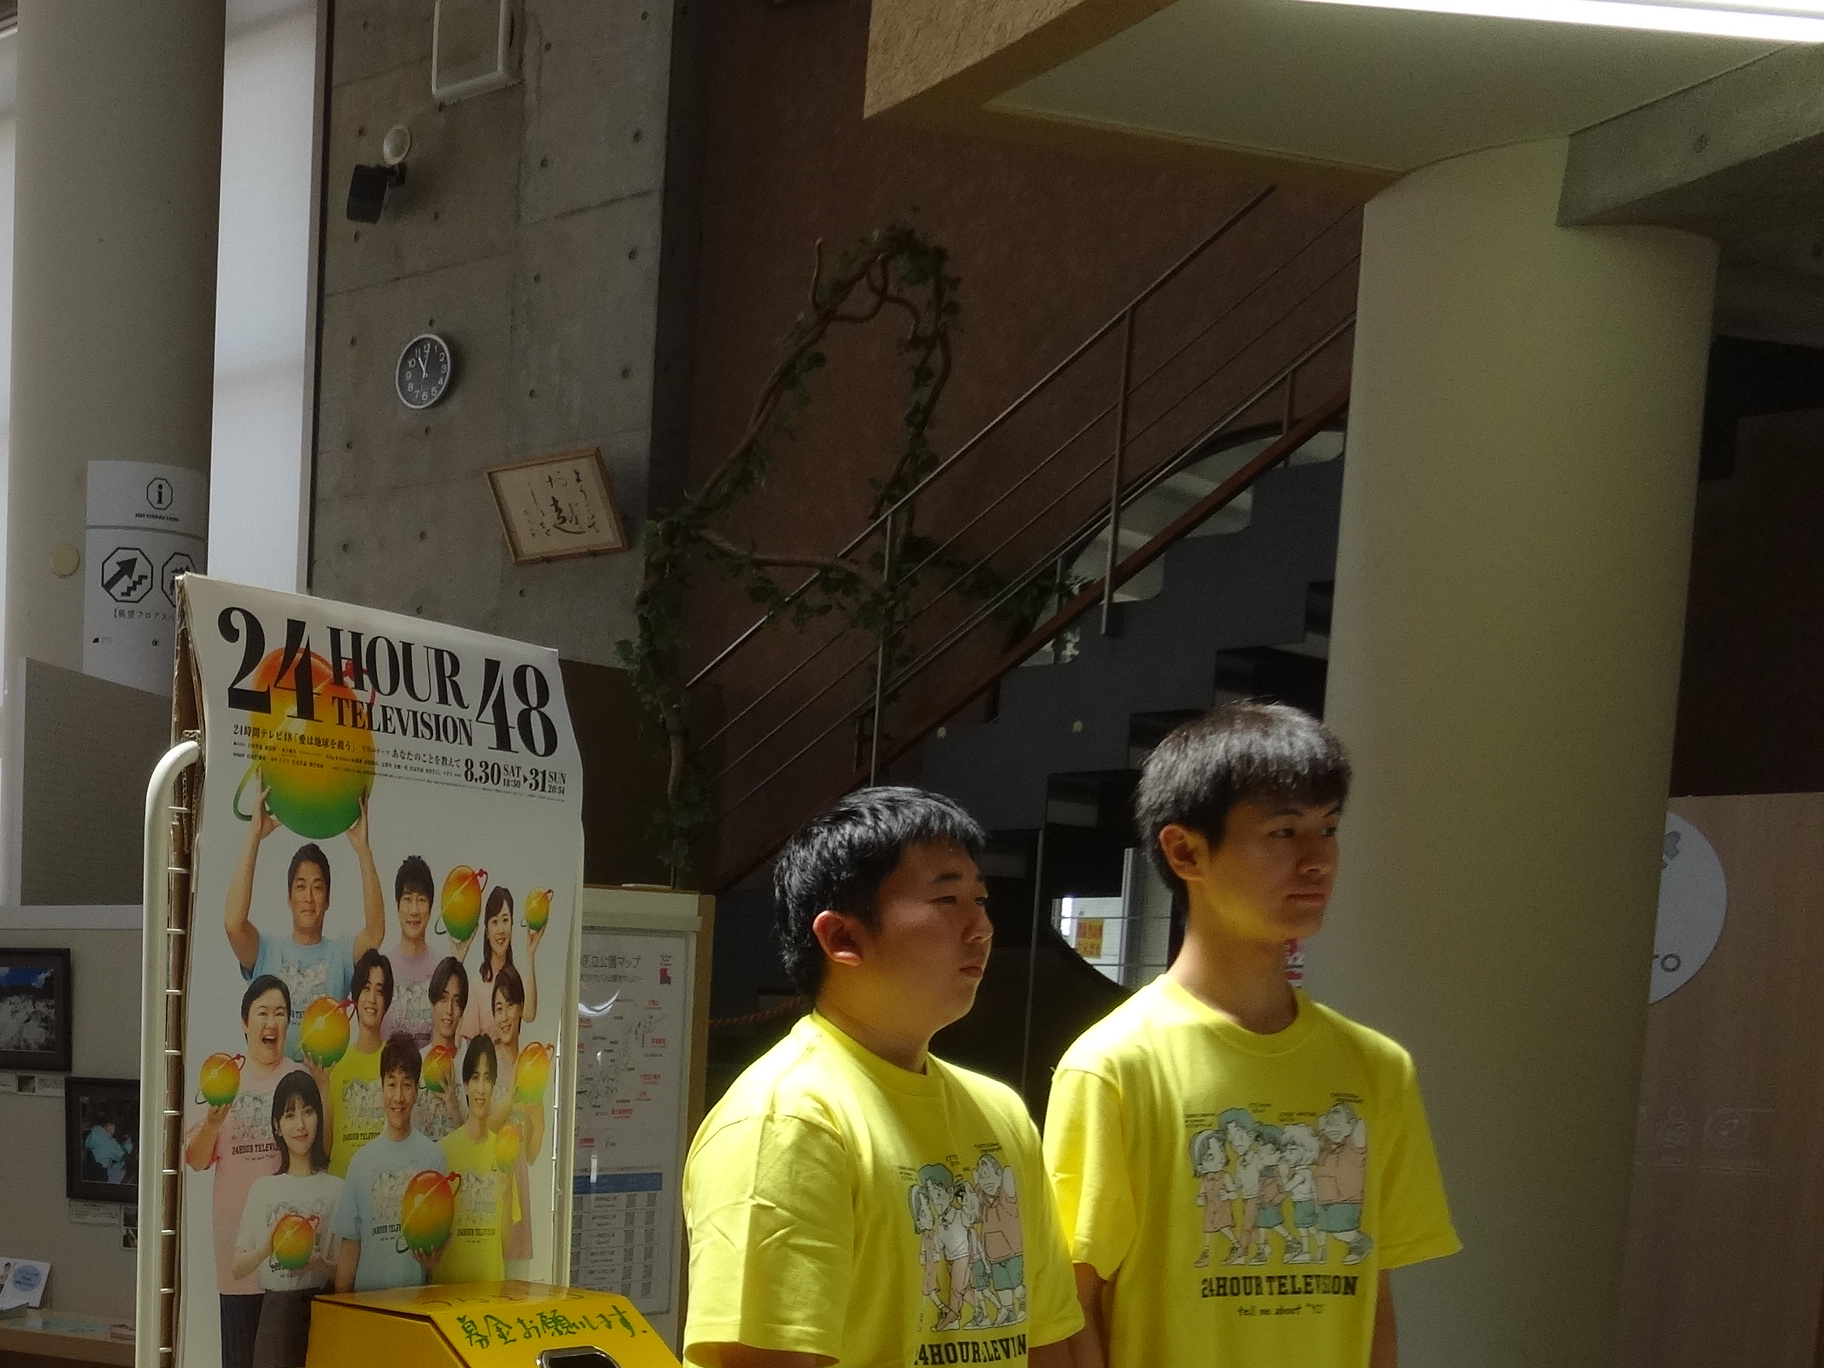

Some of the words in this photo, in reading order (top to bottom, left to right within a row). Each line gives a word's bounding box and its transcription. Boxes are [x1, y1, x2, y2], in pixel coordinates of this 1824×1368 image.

[217, 606, 323, 723] 24
[326, 625, 470, 710] HOUR
[475, 657, 558, 758] 48
[331, 697, 474, 748] TELEVISION
[464, 757, 501, 787] 8.30
[502, 765, 522, 778] SAT
[529, 767, 548, 793] 31
[547, 772, 567, 785] SUN
